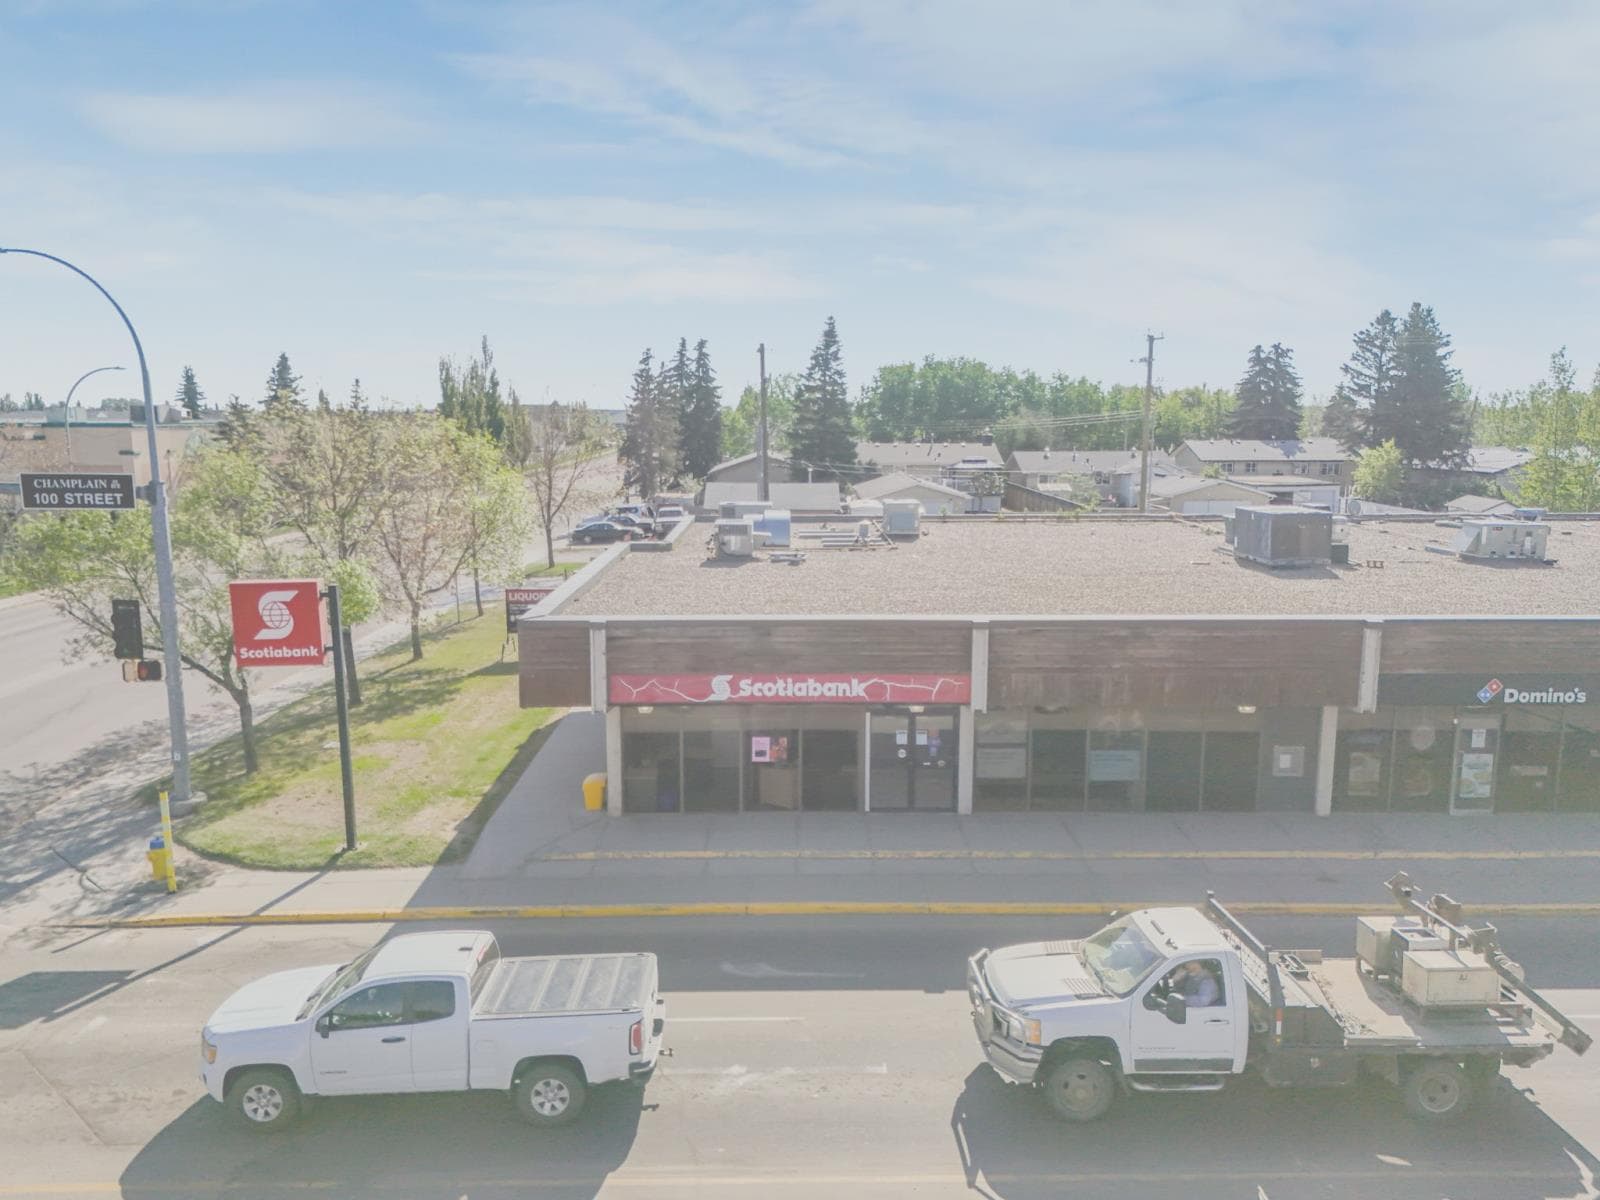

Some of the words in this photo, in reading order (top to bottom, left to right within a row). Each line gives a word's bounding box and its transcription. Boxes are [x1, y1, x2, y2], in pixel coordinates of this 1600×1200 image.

[33, 479, 107, 489] CHAMPLAIN
[33, 493, 59, 505] 100
[64, 493, 123, 505] STREET
[240, 646, 319, 659] Scotiabank
[738, 677, 865, 697] Scotiabank
[1503, 687, 1587, 703] Domino's
